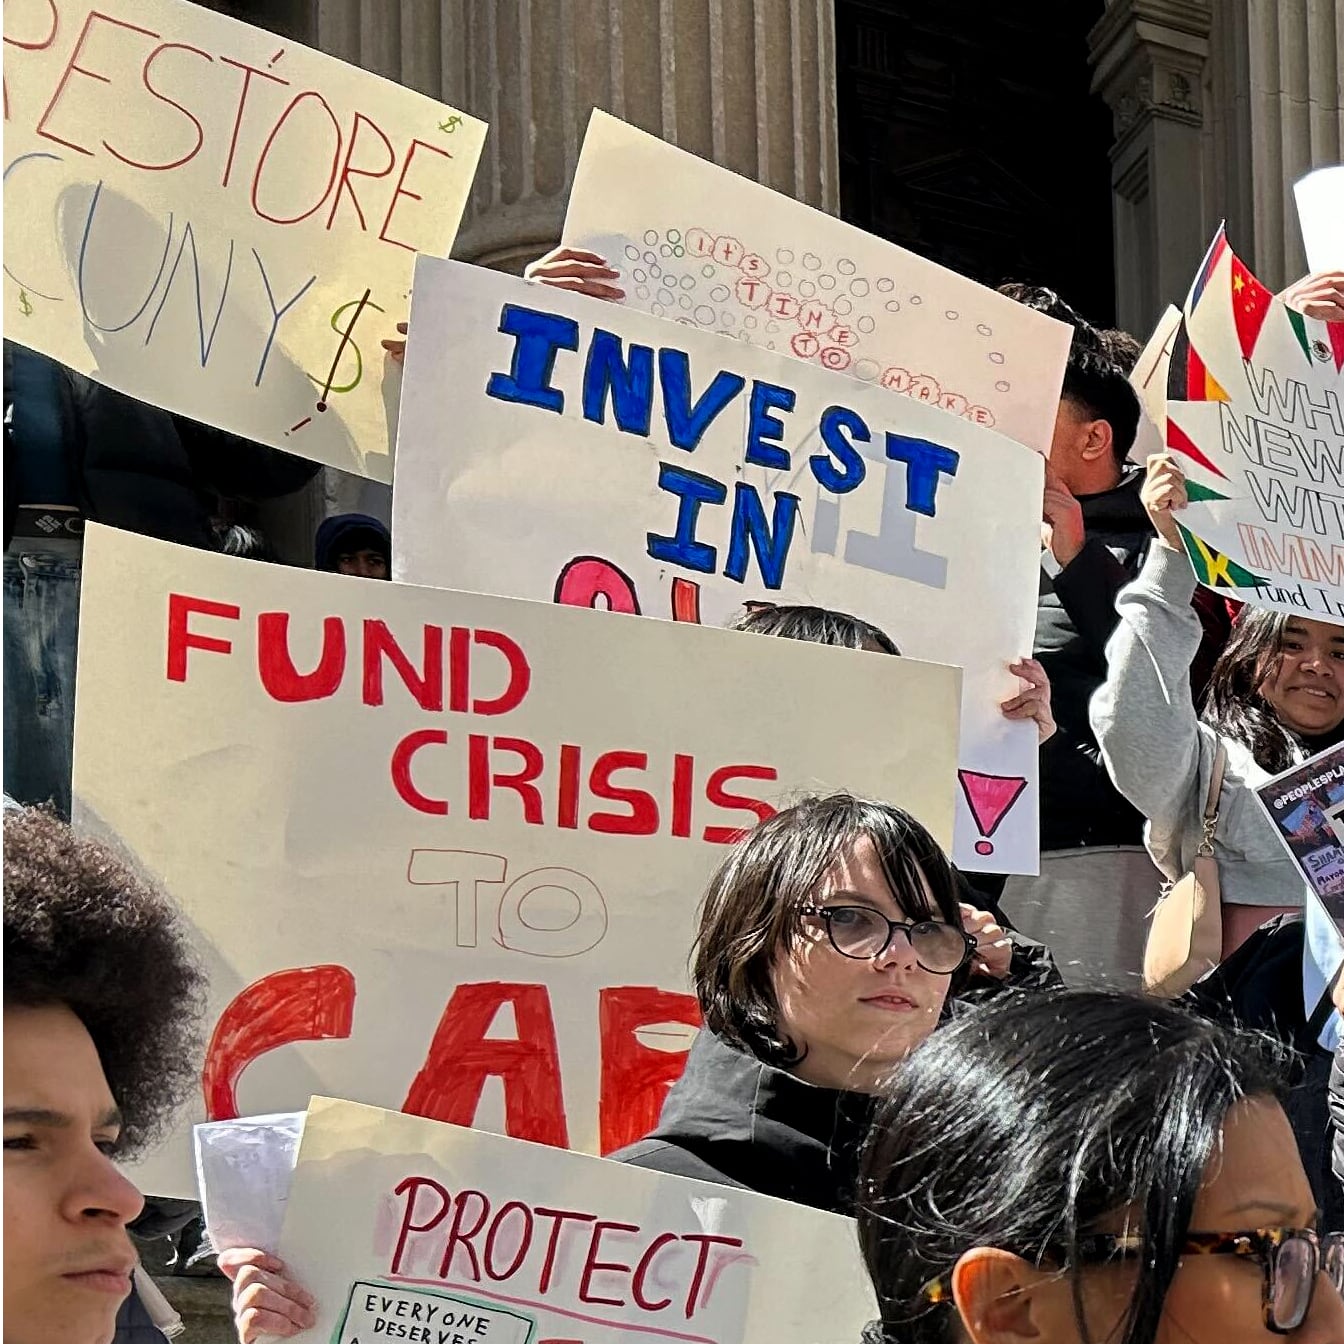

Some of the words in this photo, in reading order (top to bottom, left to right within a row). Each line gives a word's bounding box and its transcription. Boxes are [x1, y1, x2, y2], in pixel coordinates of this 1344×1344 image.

[744, 280, 850, 344] TIME
[797, 336, 842, 367] TO
[487, 303, 959, 518] INVEST
[887, 373, 989, 425] MAKE
[647, 462, 801, 590] IN
[166, 592, 532, 717] FUND
[390, 728, 780, 845] CRISIS
[407, 847, 608, 958] TO
[390, 1175, 743, 1319] PROTECT
